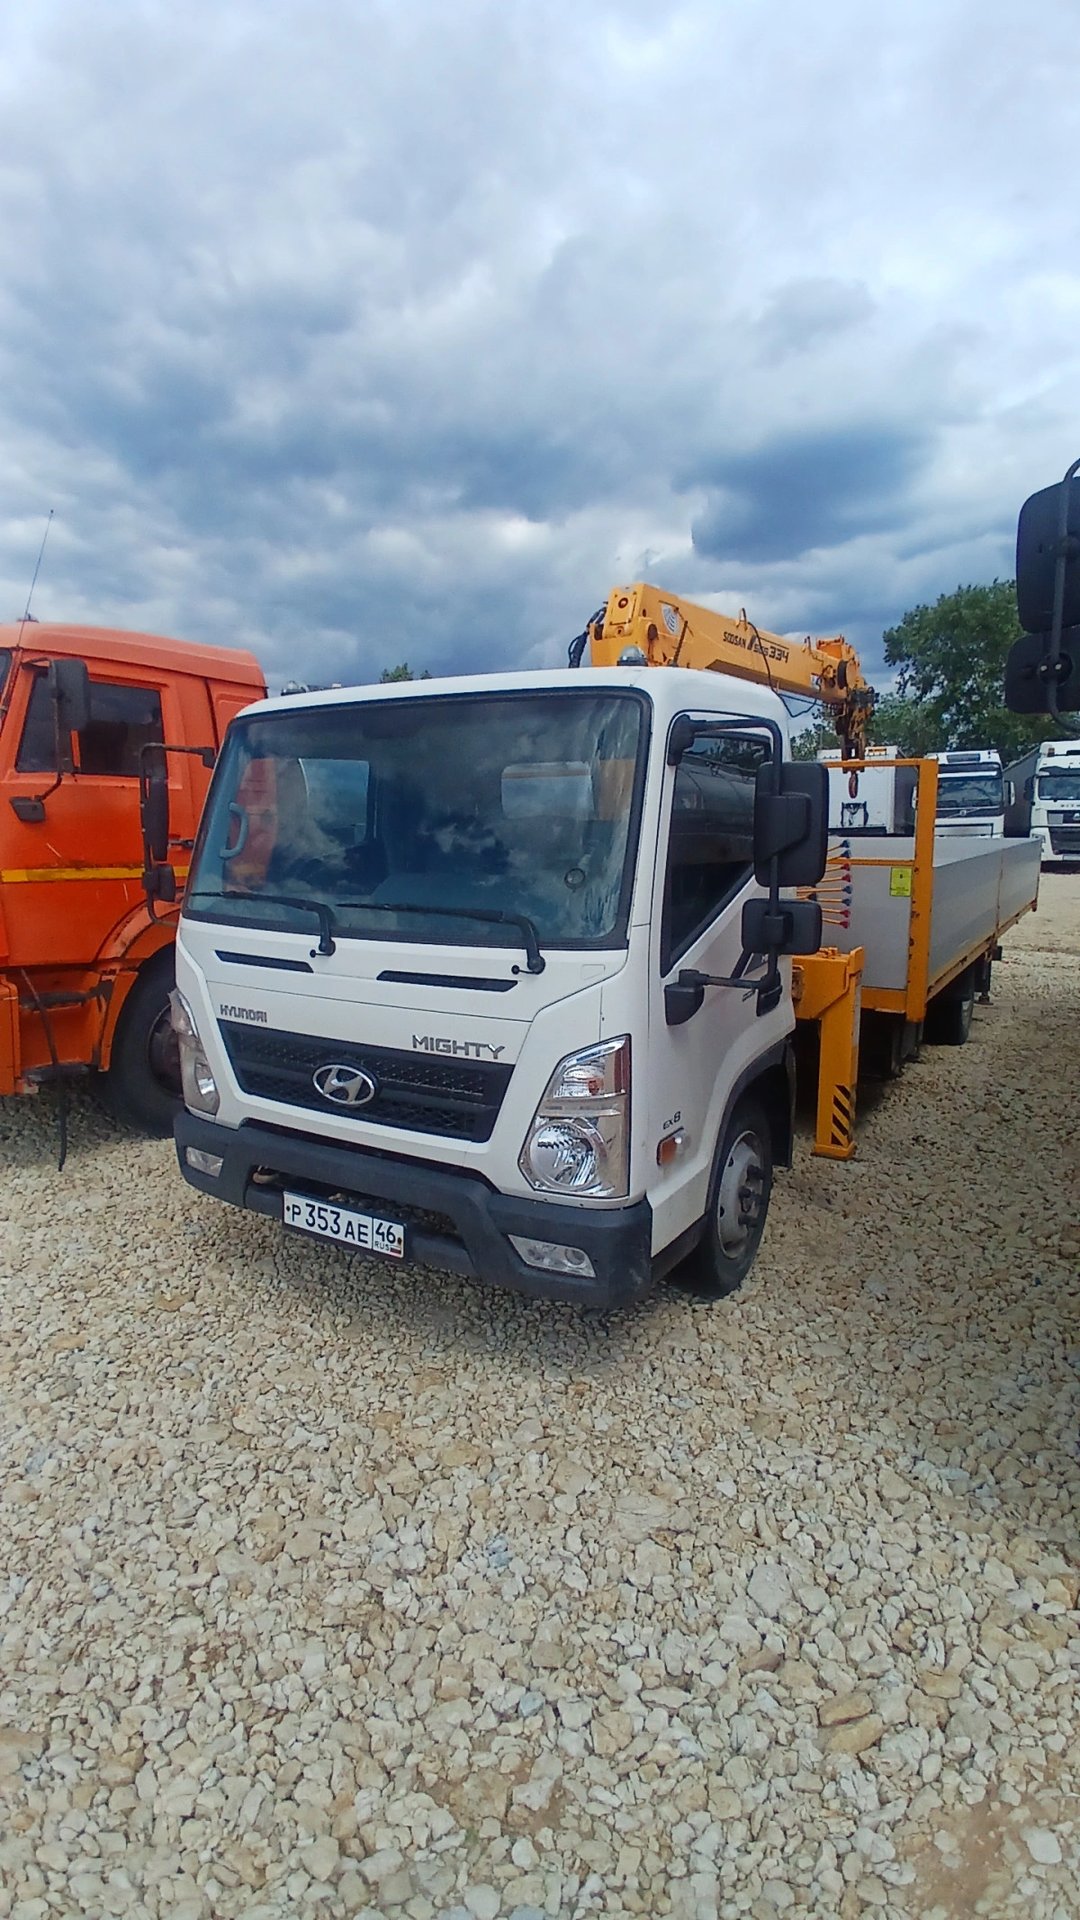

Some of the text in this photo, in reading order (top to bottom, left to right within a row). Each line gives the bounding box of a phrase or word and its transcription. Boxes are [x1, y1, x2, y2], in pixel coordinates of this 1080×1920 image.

[723, 631, 746, 649] SOOSAN
[220, 1004, 267, 1023] HYUNDAI
[412, 1034, 505, 1060] MIGHTY
[375, 1222, 396, 1244] 46
[374, 1241, 390, 1251] RUS
